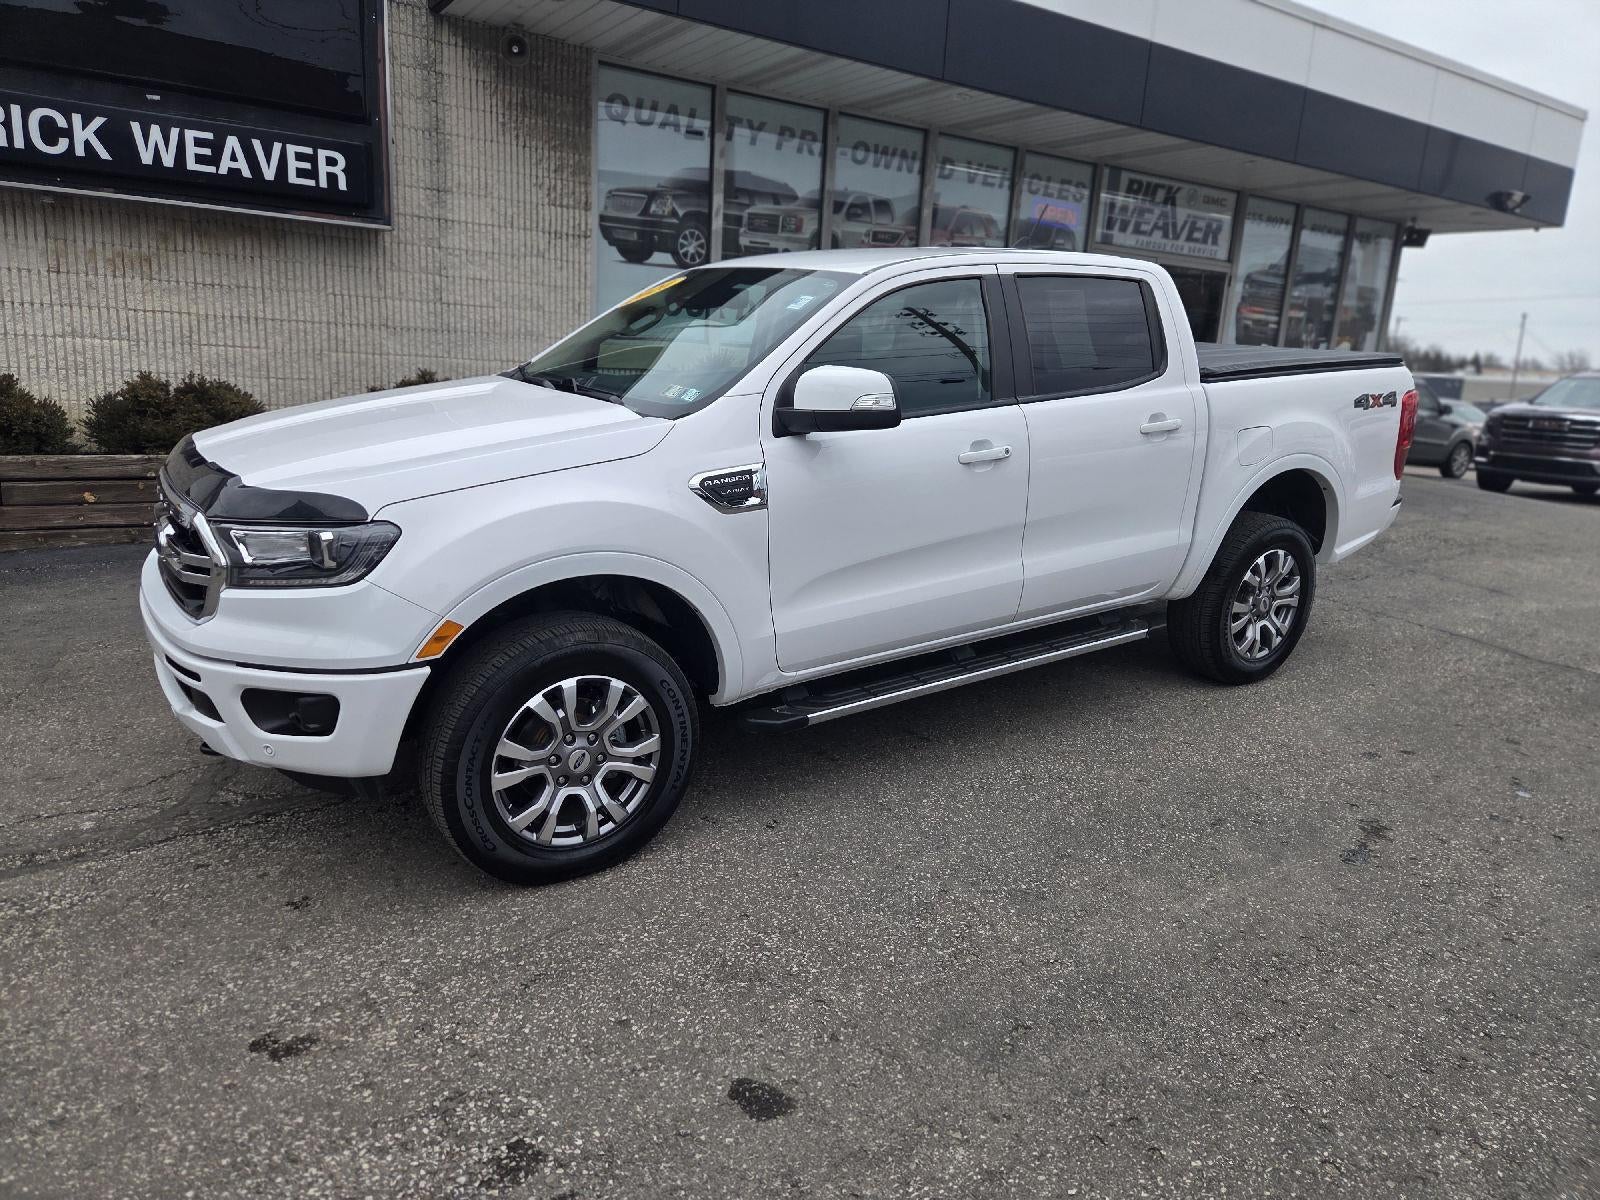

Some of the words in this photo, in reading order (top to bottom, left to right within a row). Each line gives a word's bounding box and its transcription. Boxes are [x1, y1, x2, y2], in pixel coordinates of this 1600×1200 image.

[0, 103, 113, 161] ICK
[129, 120, 348, 191] WEAVER
[604, 92, 767, 146] QUALTY
[775, 125, 955, 180] PR-OWND
[965, 160, 1088, 202] VEHCLES
[1105, 200, 1225, 247] WEAVER
[1125, 177, 1186, 206] RICK
[704, 474, 750, 487] RANGER
[659, 678, 690, 793] CONTINENTAL
